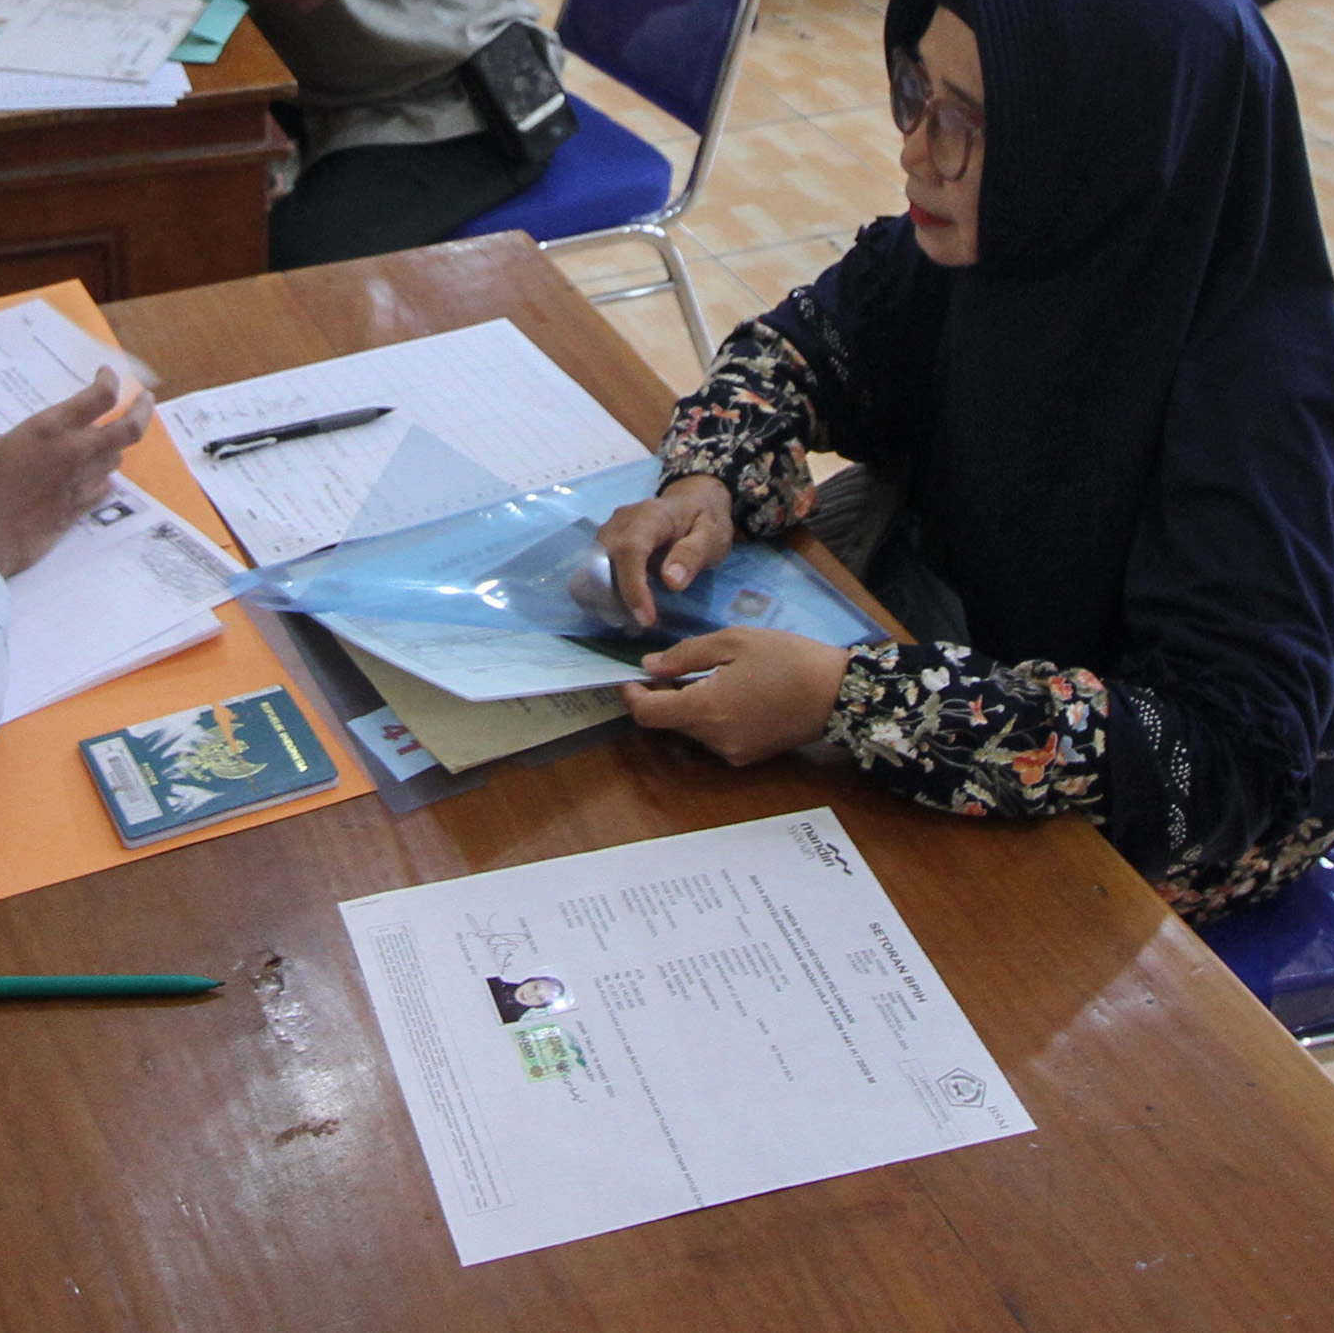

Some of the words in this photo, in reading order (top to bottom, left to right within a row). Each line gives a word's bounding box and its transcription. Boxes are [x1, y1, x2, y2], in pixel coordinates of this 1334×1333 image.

[259, 701, 285, 733] REPUBLIK
[278, 731, 309, 773] INDONESIA
[382, 723, 422, 757] 41
[800, 822, 839, 867] mandiri
[782, 904, 798, 927] TANDA
[806, 948, 830, 981] SETORAN
[826, 981, 856, 1024] PELUNASAN
[869, 922, 908, 974] SETORAN
[902, 975, 927, 1003] BPIH
[826, 1005, 844, 1031] TAHUN
[987, 1105, 1010, 1130] BSM
